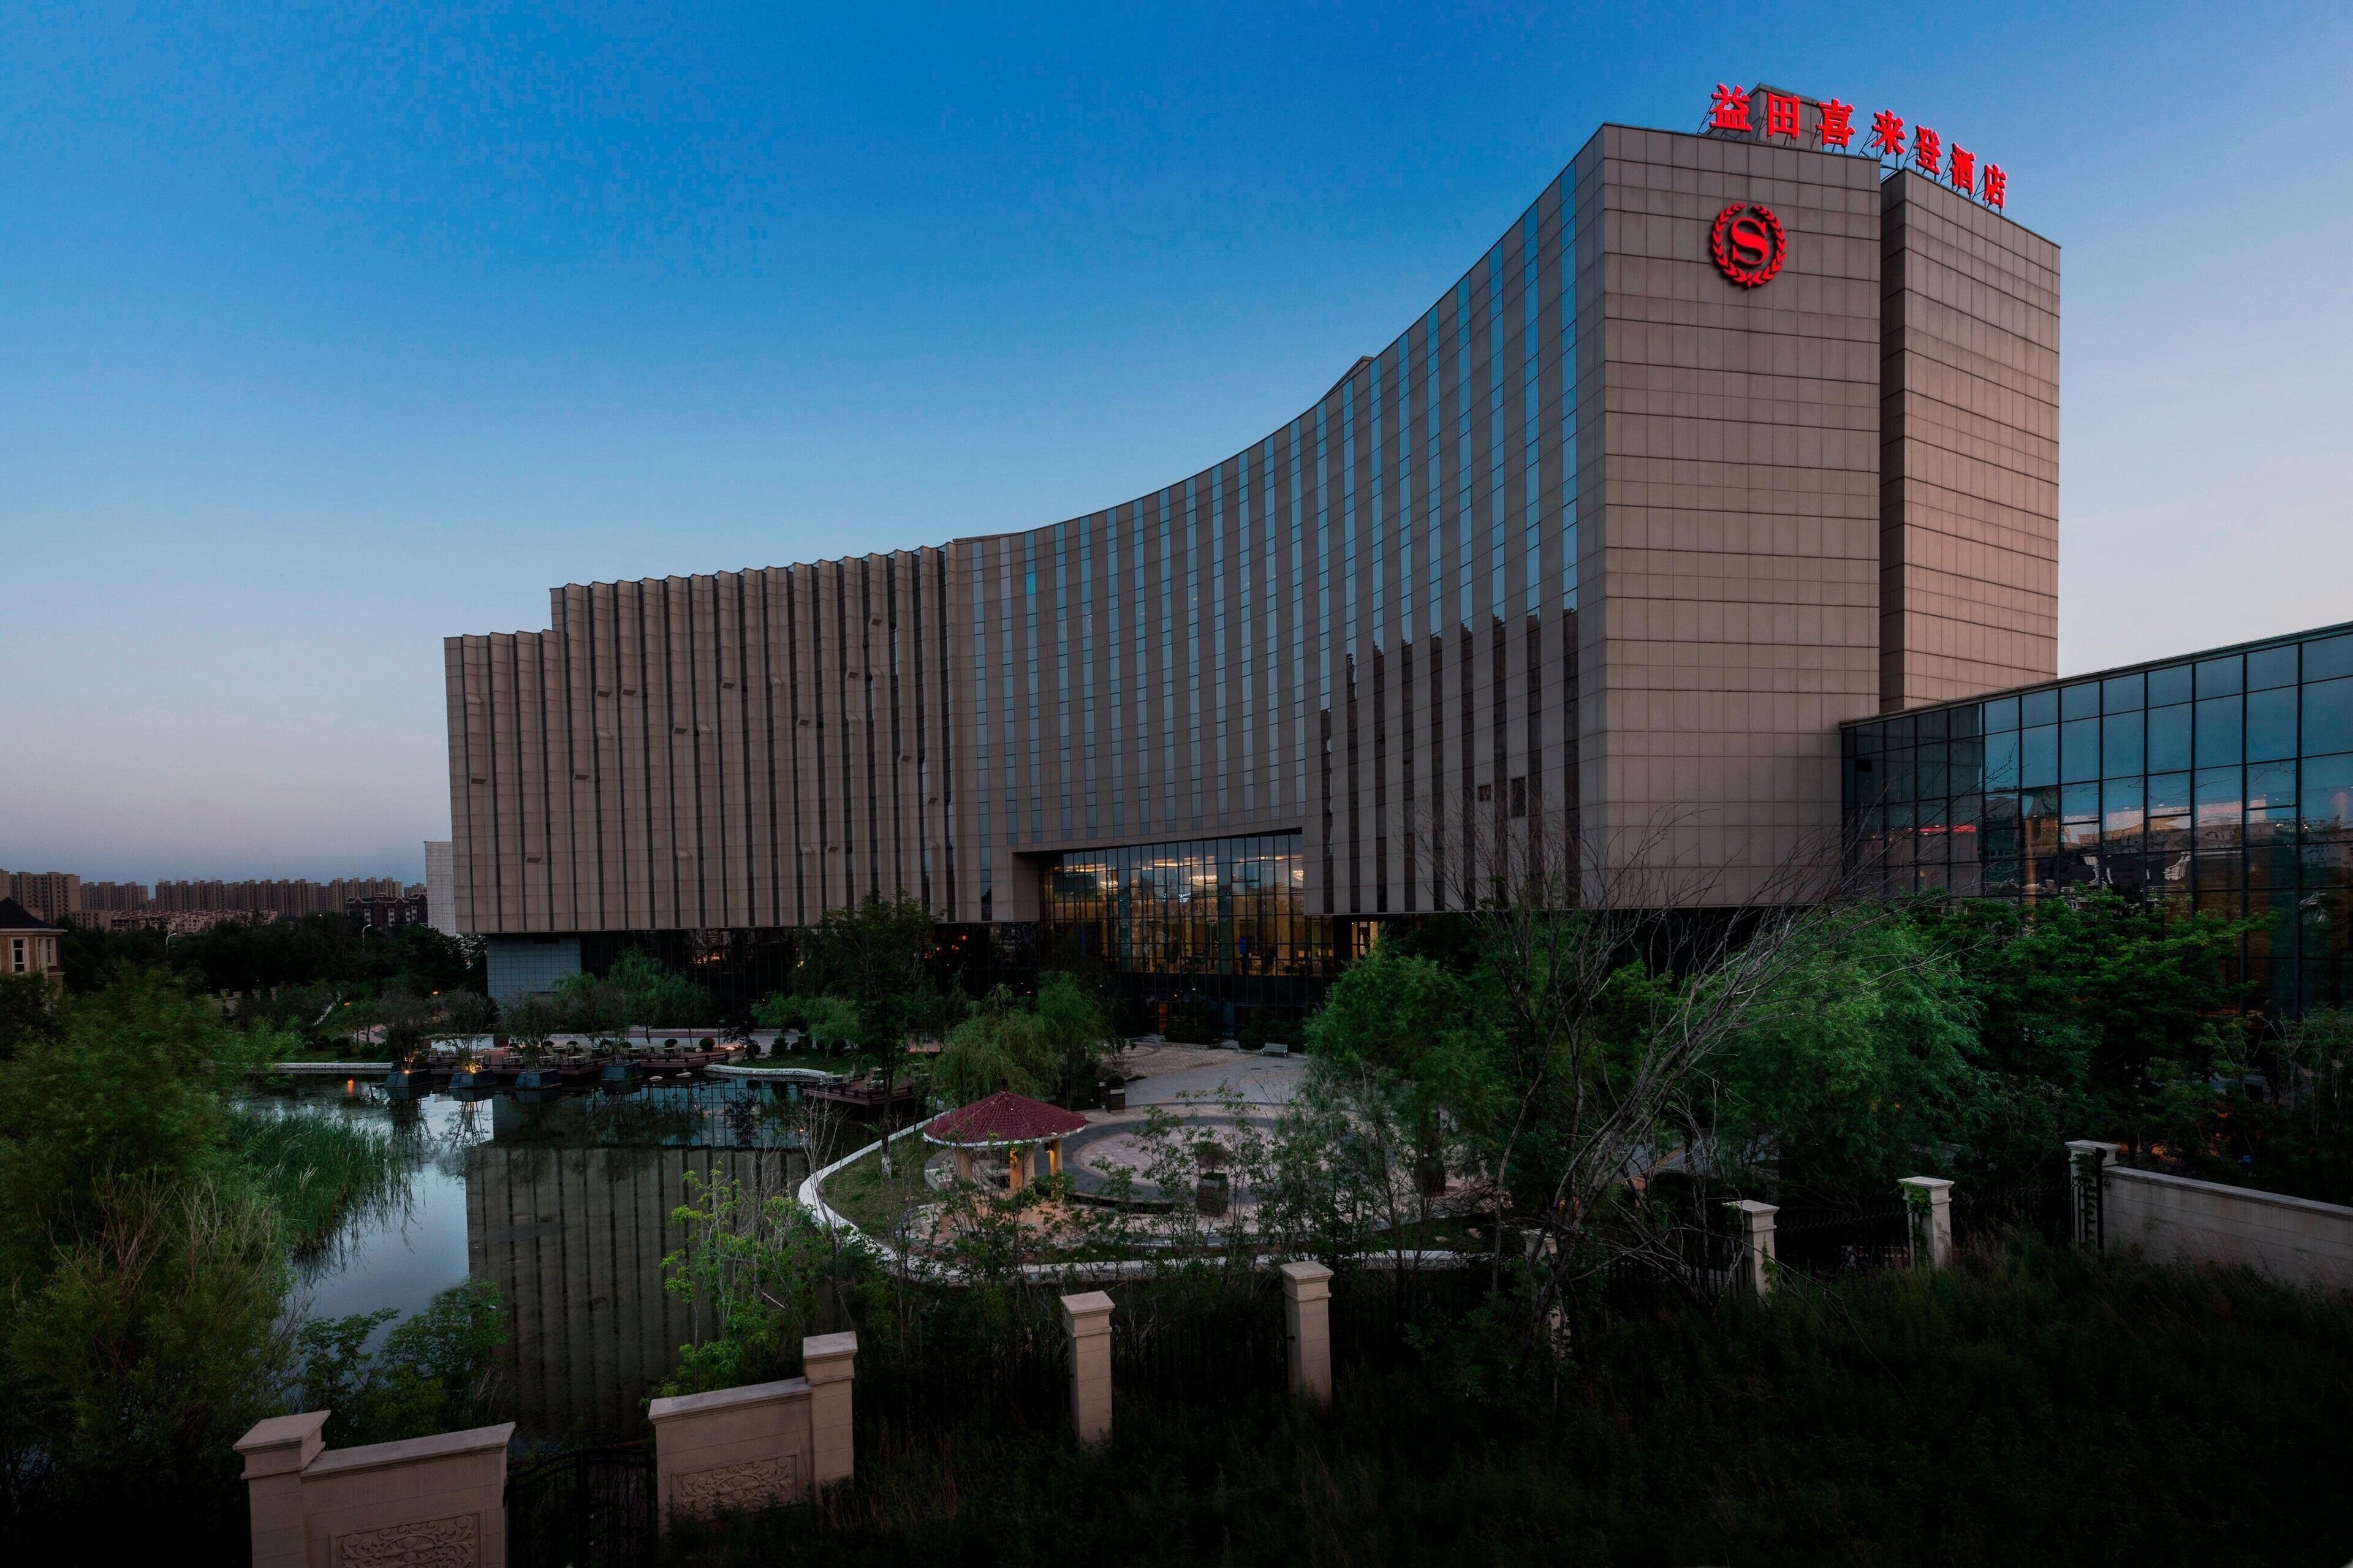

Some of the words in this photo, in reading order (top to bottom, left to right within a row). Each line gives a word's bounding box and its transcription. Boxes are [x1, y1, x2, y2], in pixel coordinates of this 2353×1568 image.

[1709, 83, 2008, 209] 益田喜来登酒店
[1729, 216, 1770, 266] S
